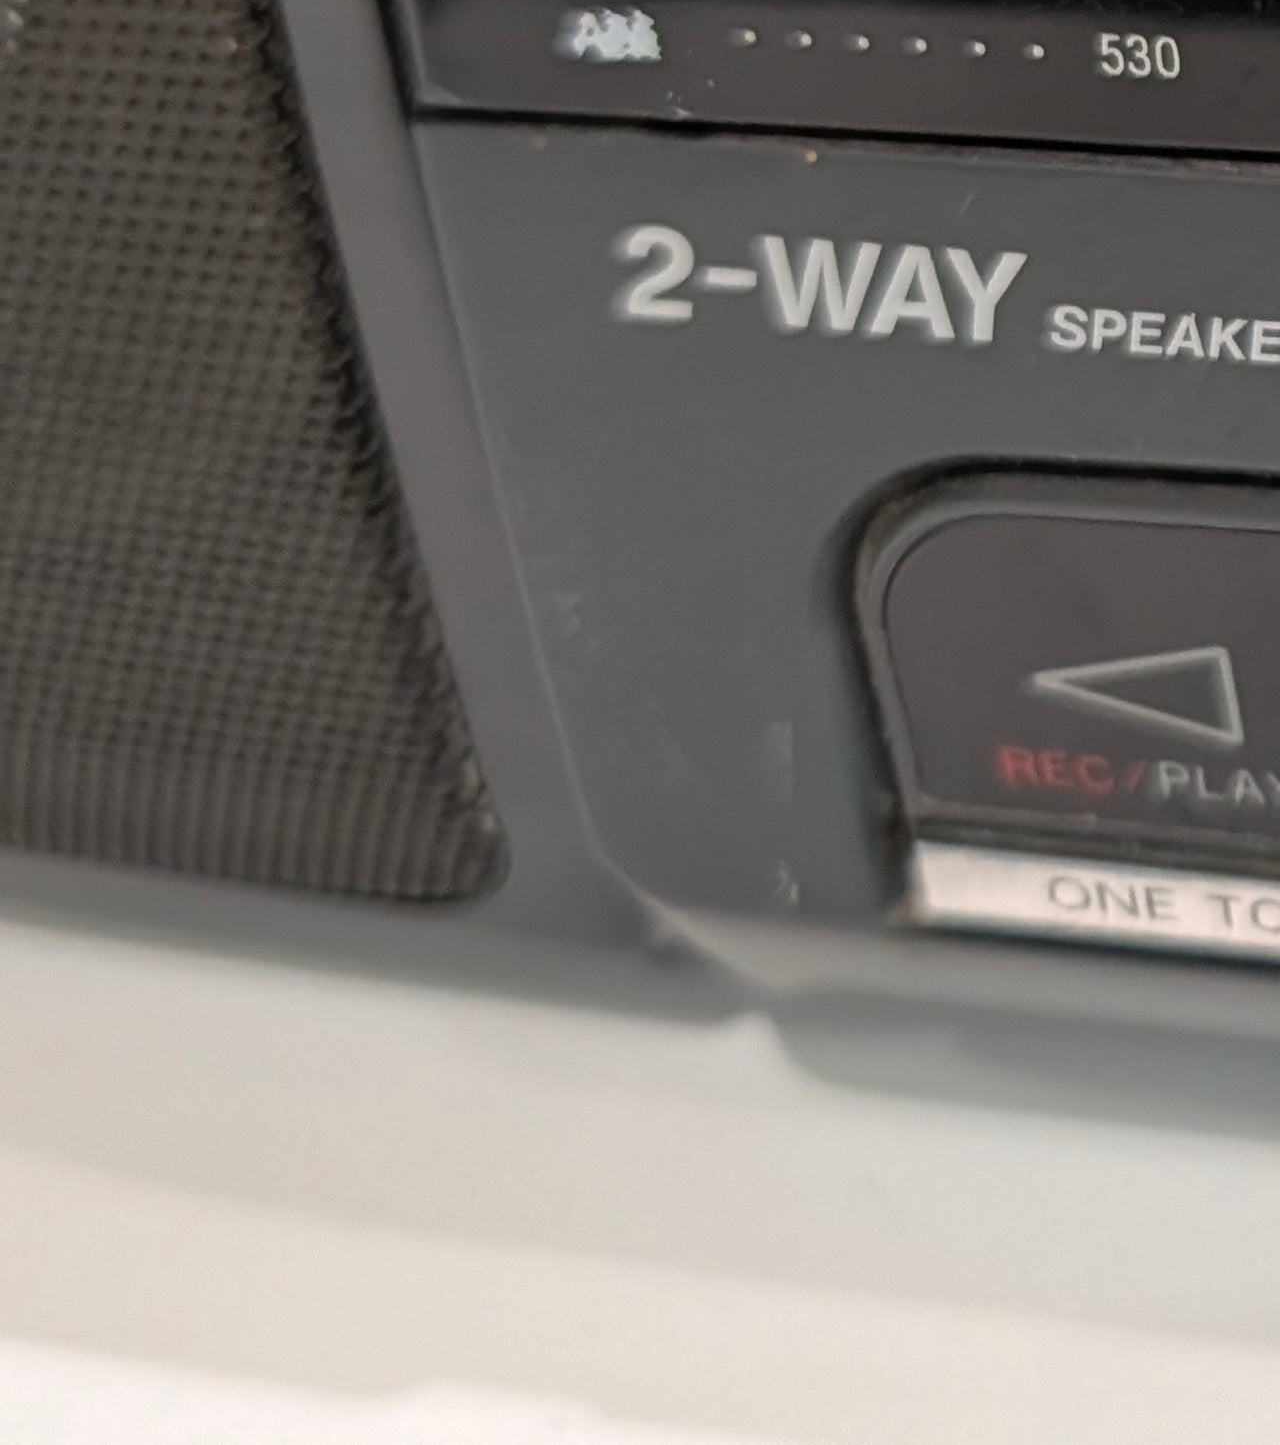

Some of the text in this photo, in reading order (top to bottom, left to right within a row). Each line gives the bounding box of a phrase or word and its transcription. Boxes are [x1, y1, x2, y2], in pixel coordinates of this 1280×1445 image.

[1096, 30, 1184, 81] 530
[614, 223, 1027, 343] 2-WAY
[1048, 874, 1179, 922] ONE
